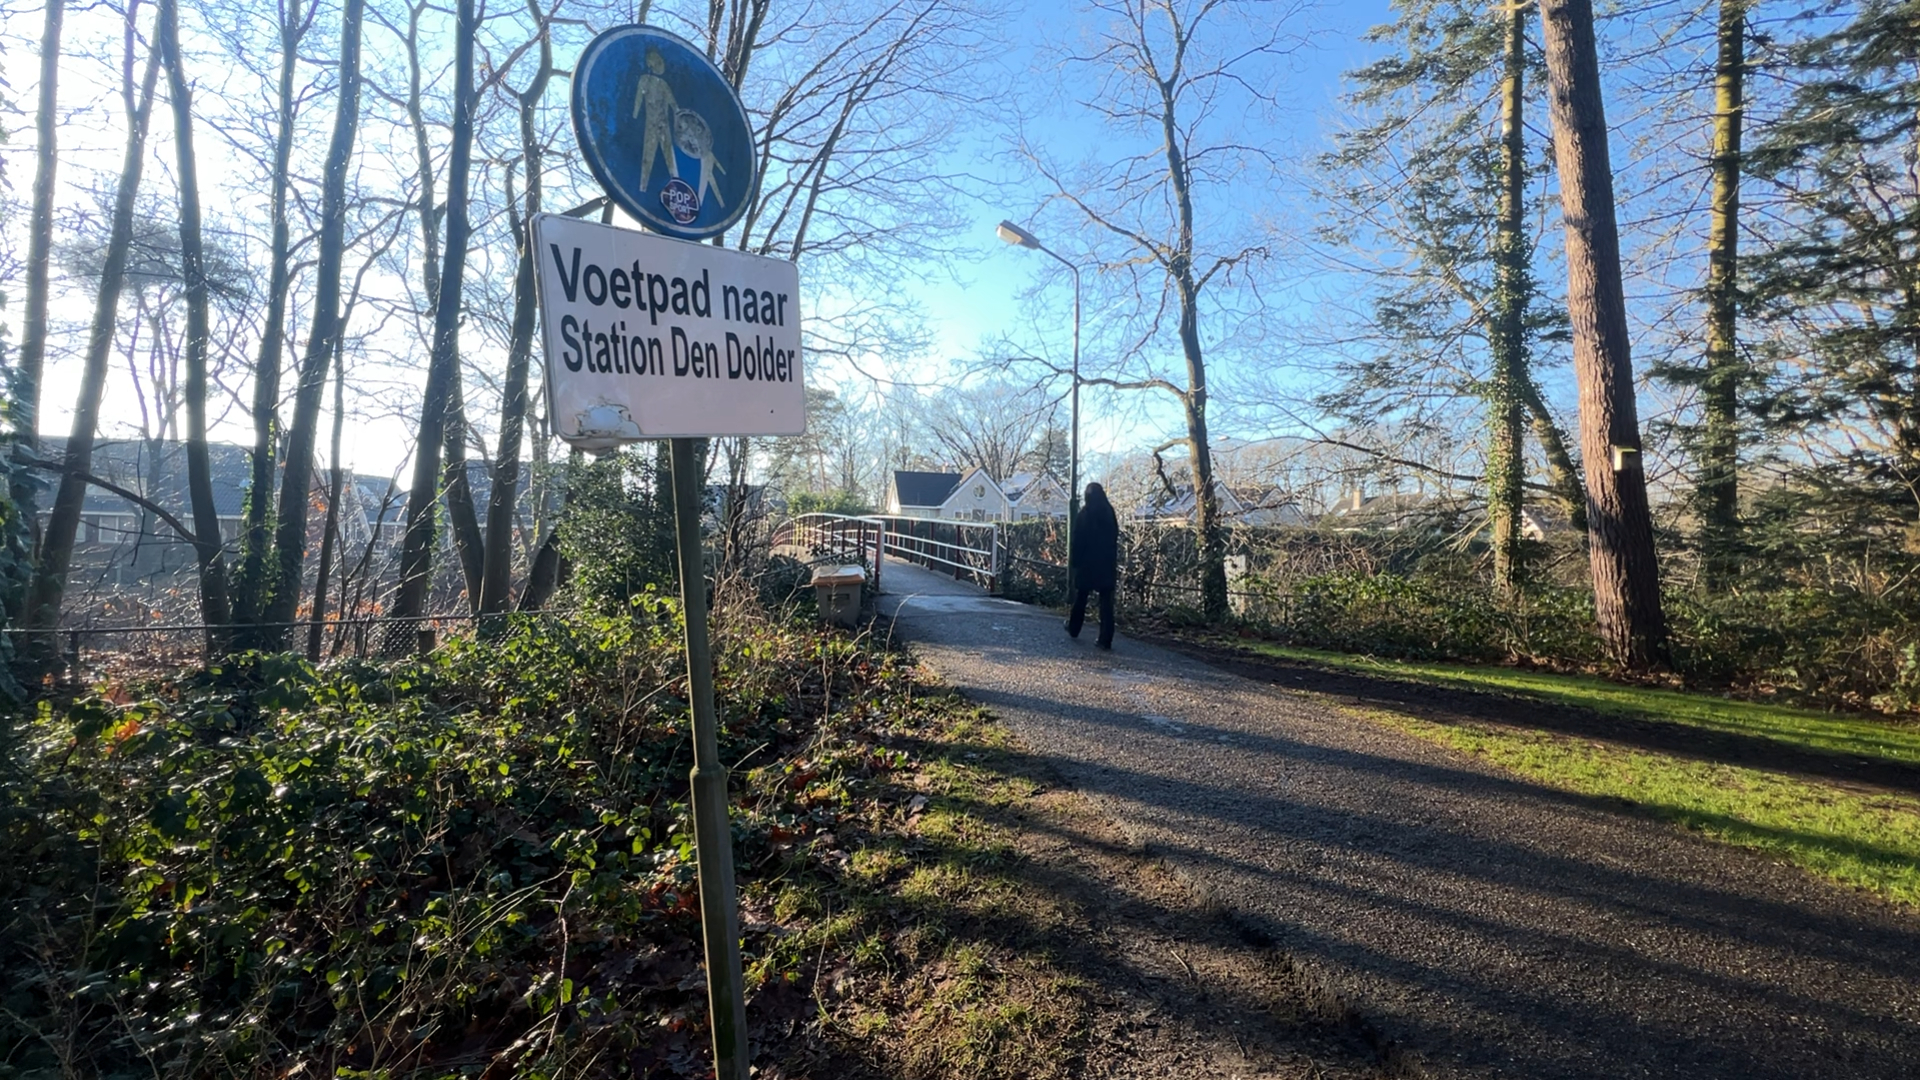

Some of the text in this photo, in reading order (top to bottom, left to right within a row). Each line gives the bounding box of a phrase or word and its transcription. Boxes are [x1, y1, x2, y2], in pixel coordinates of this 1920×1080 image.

[669, 189, 691, 204] POP
[550, 243, 788, 326] Voetpad naar
[561, 314, 795, 382] Station Den Dolder
